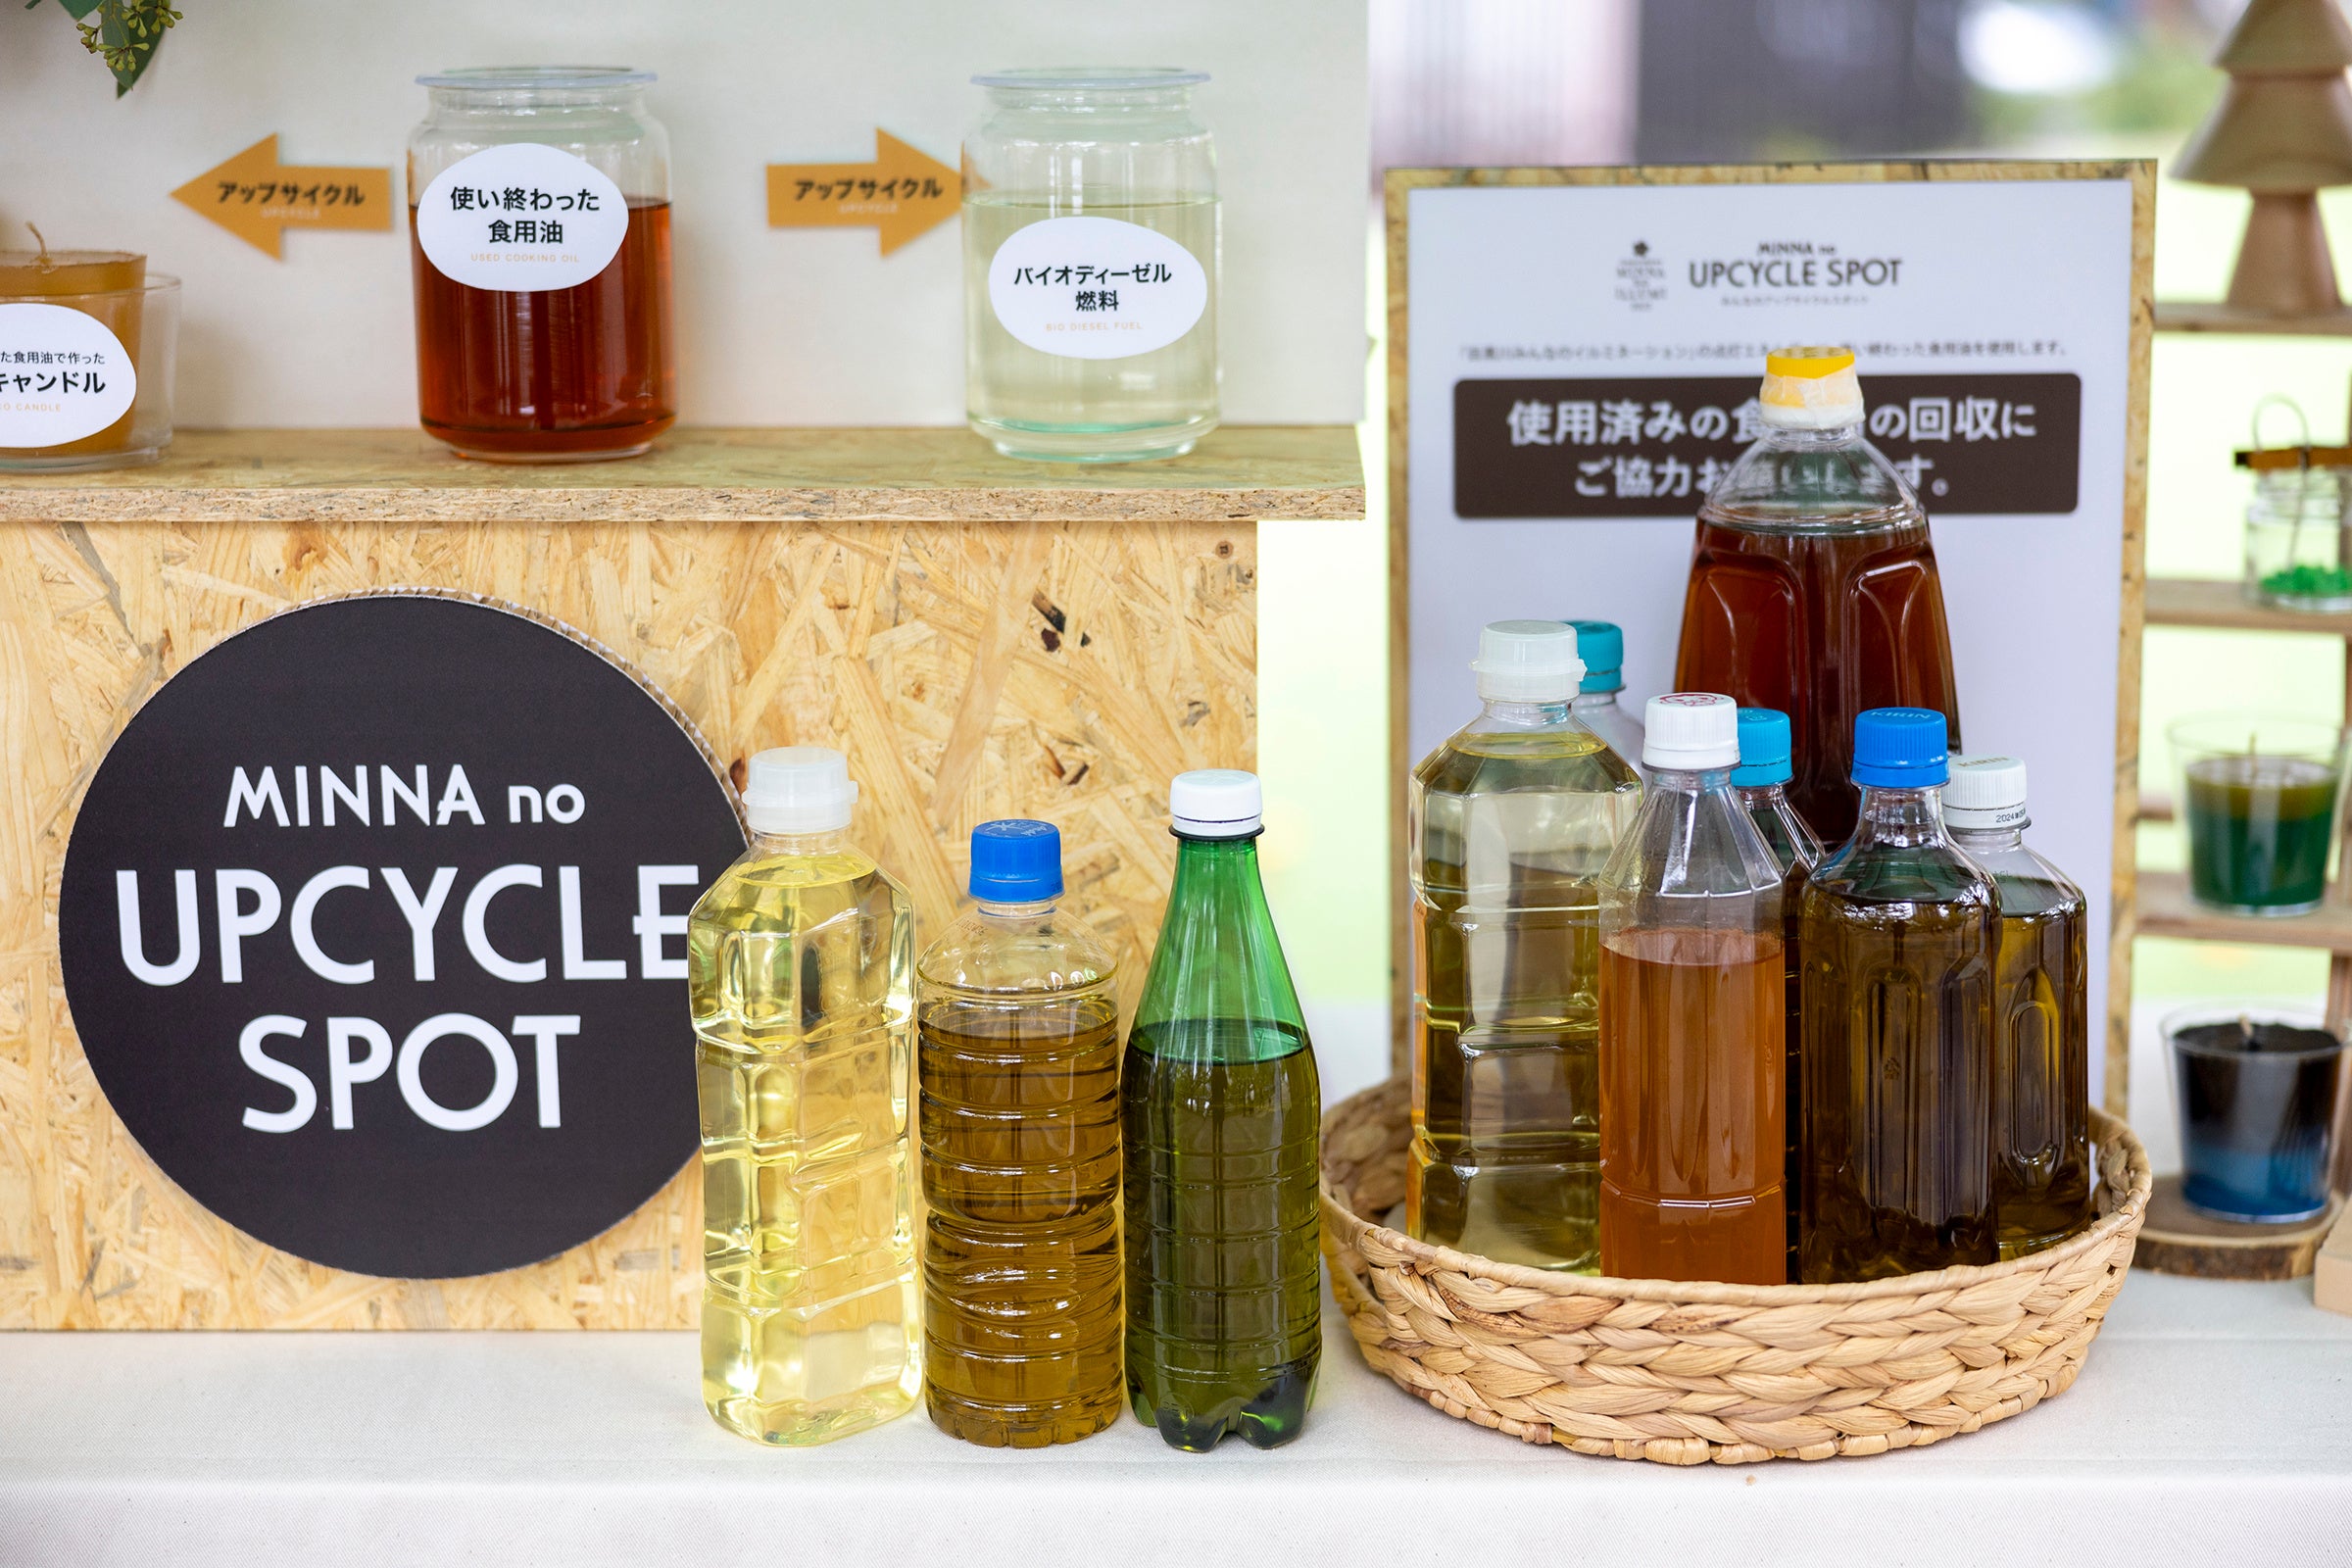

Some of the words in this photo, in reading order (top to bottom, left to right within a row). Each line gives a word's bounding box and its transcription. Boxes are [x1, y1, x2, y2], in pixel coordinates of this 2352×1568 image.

[219, 183, 366, 208] アップサイクル
[451, 186, 600, 212] 使い終わった
[795, 178, 944, 204] アップサイクル
[488, 220, 564, 244] 食用油
[470, 253, 500, 263] USED
[506, 254, 556, 263] COOKING
[562, 254, 580, 263] OIL
[1757, 241, 1813, 255] MINNA
[1014, 264, 1172, 286] バイオディーゼル
[1689, 260, 1816, 287] UPCYCLE
[1827, 259, 1902, 286] SPOT
[1075, 290, 1119, 312] 燃料
[1045, 322, 1065, 332] BIO
[1070, 321, 1109, 331] DIESEL
[1114, 321, 1143, 330] FUEL
[0, 351, 105, 365] た食用油で作った
[16, 403, 61, 413] CANDLE
[1506, 394, 2036, 447] 使用済みの食の回収に
[1871, 710, 1932, 719] KIRIN
[223, 764, 486, 828] MINNA
[508, 783, 586, 824] no
[116, 863, 699, 987] UPCYCLE
[238, 1012, 581, 1134] SPOT
